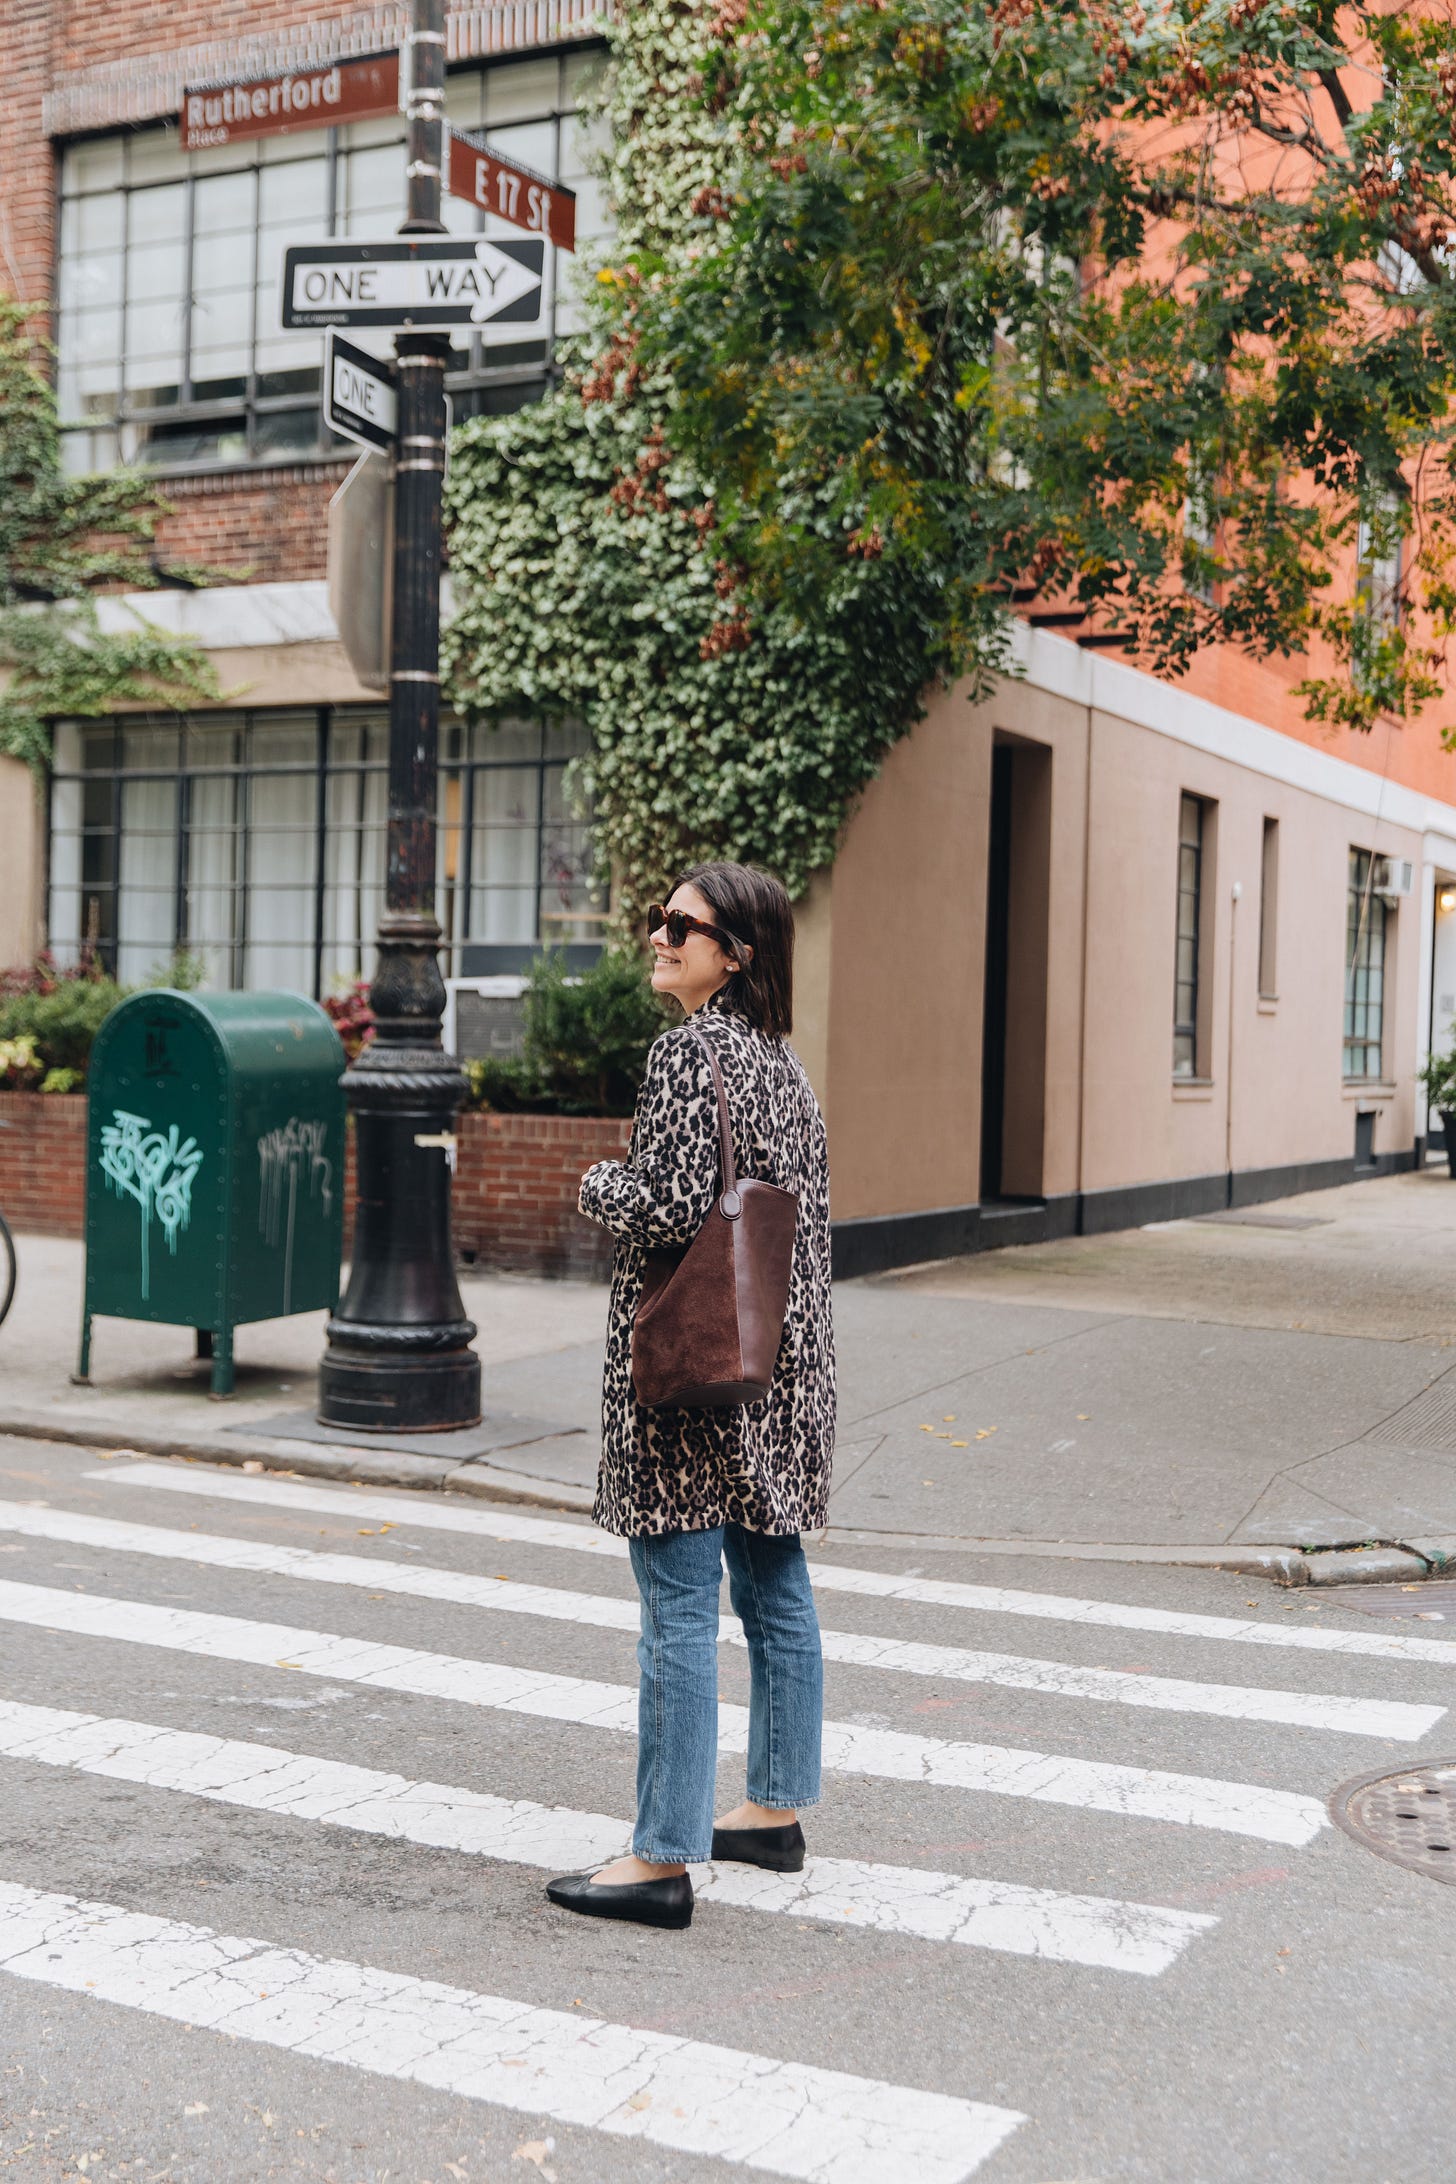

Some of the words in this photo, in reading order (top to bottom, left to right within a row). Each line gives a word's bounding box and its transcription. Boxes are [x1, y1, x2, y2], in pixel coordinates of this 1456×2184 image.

[187, 67, 341, 129] Rutherford
[475, 158, 490, 206] E
[496, 169, 521, 219] 17
[527, 185, 552, 235] St
[304, 269, 378, 302] ONE
[425, 265, 506, 298] WAY
[338, 367, 376, 416] ONE
